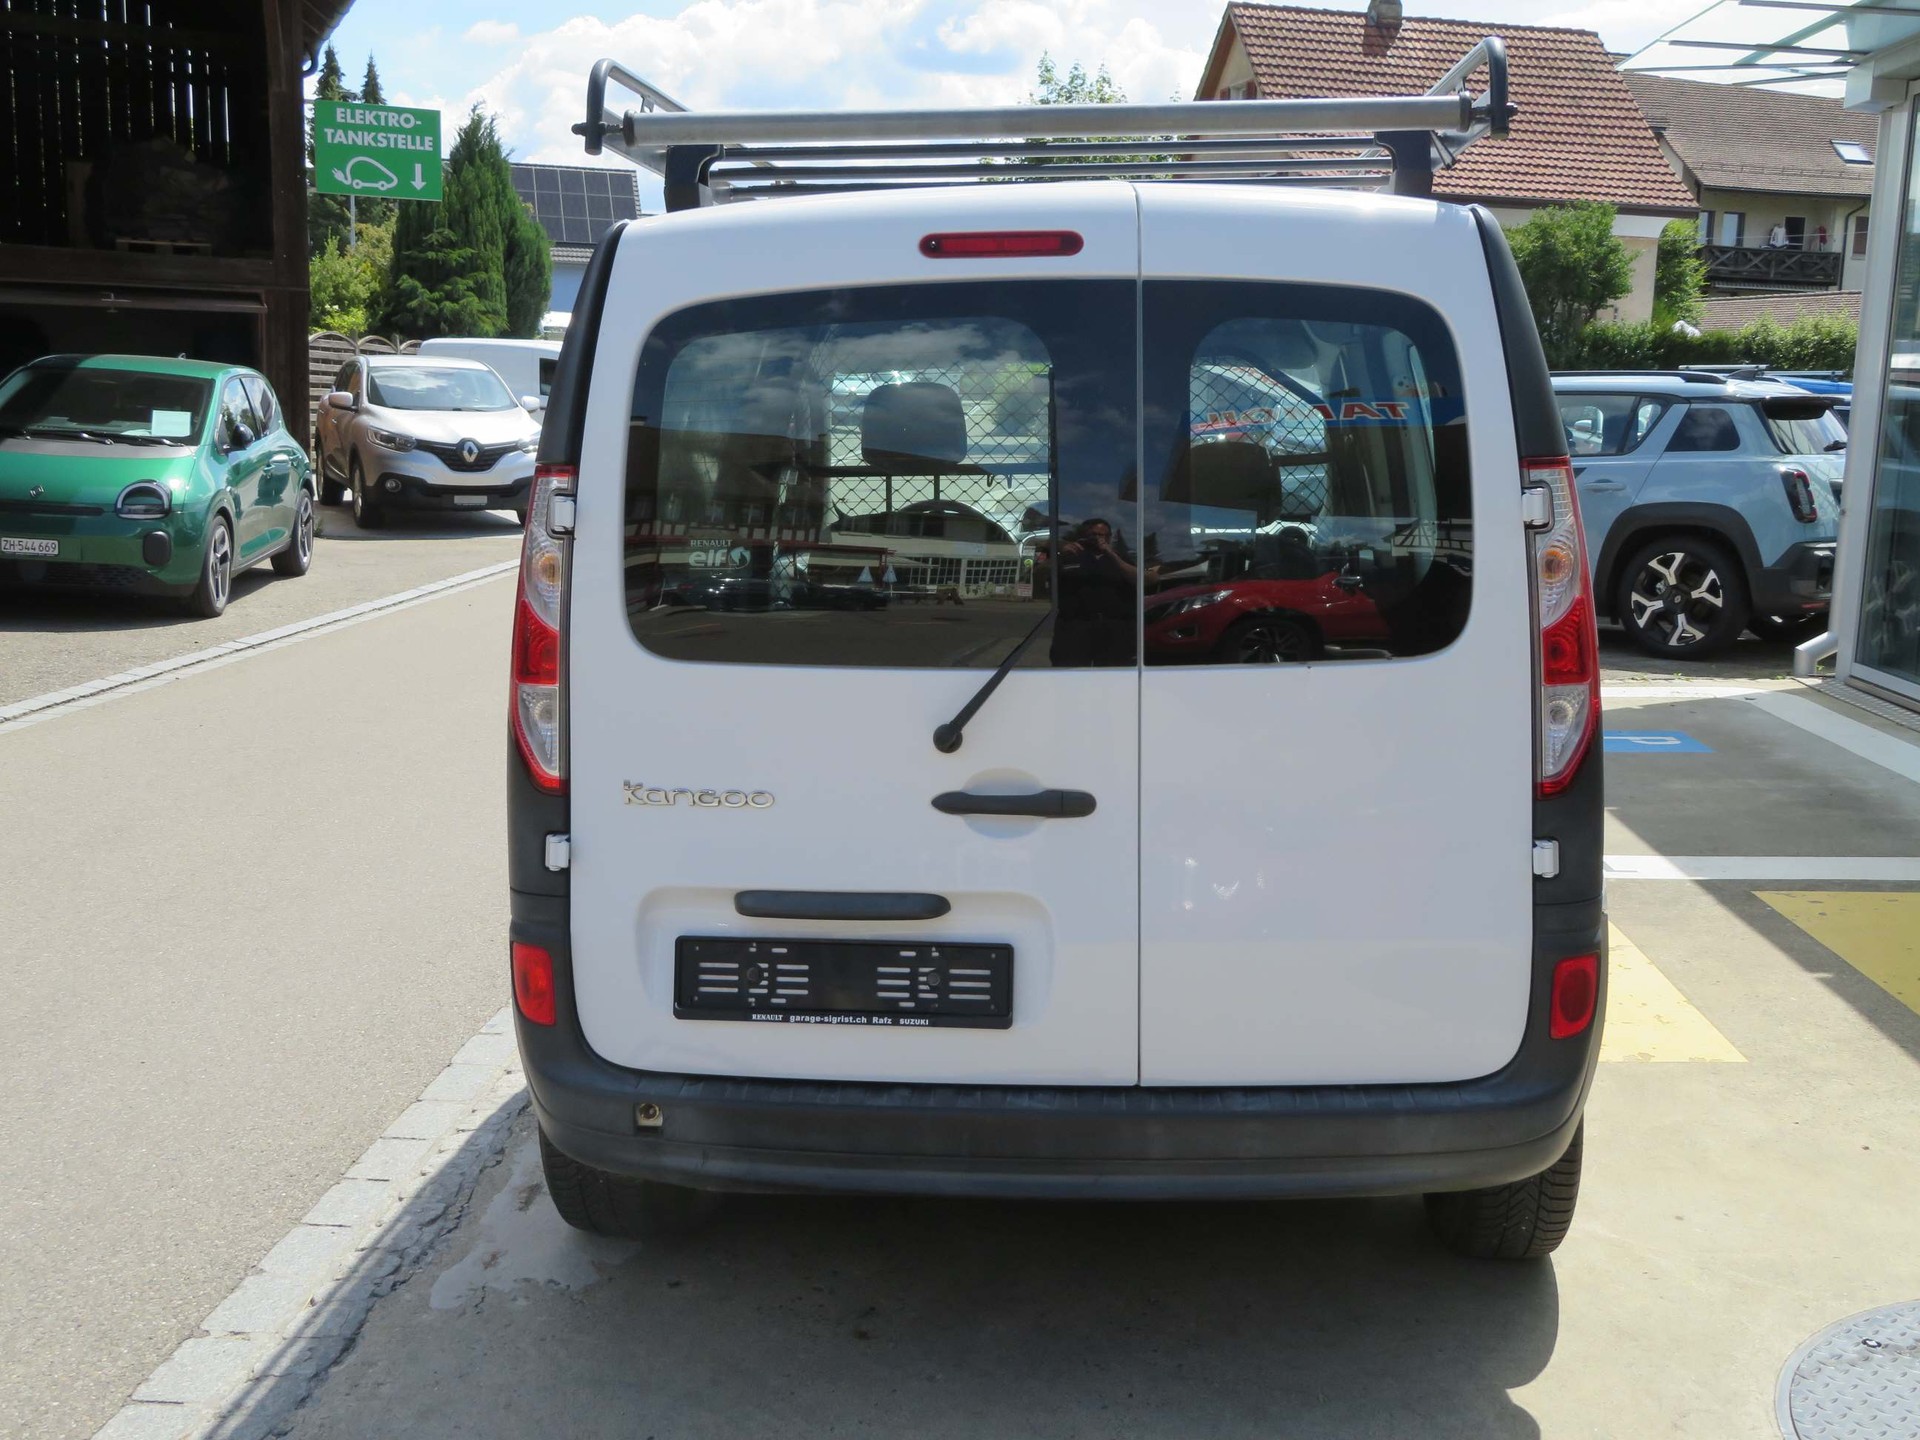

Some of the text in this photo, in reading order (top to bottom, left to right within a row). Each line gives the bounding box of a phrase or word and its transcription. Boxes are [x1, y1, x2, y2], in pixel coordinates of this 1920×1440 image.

[336, 107, 422, 129] ELEKTRO-
[323, 128, 433, 151] TANKSTELLE
[690, 539, 733, 547] RENAULT
[688, 549, 728, 567] elf
[752, 1013, 783, 1021] RENAULT
[789, 1014, 867, 1024] garage-sigrist.ch
[872, 1016, 892, 1025] Rafz
